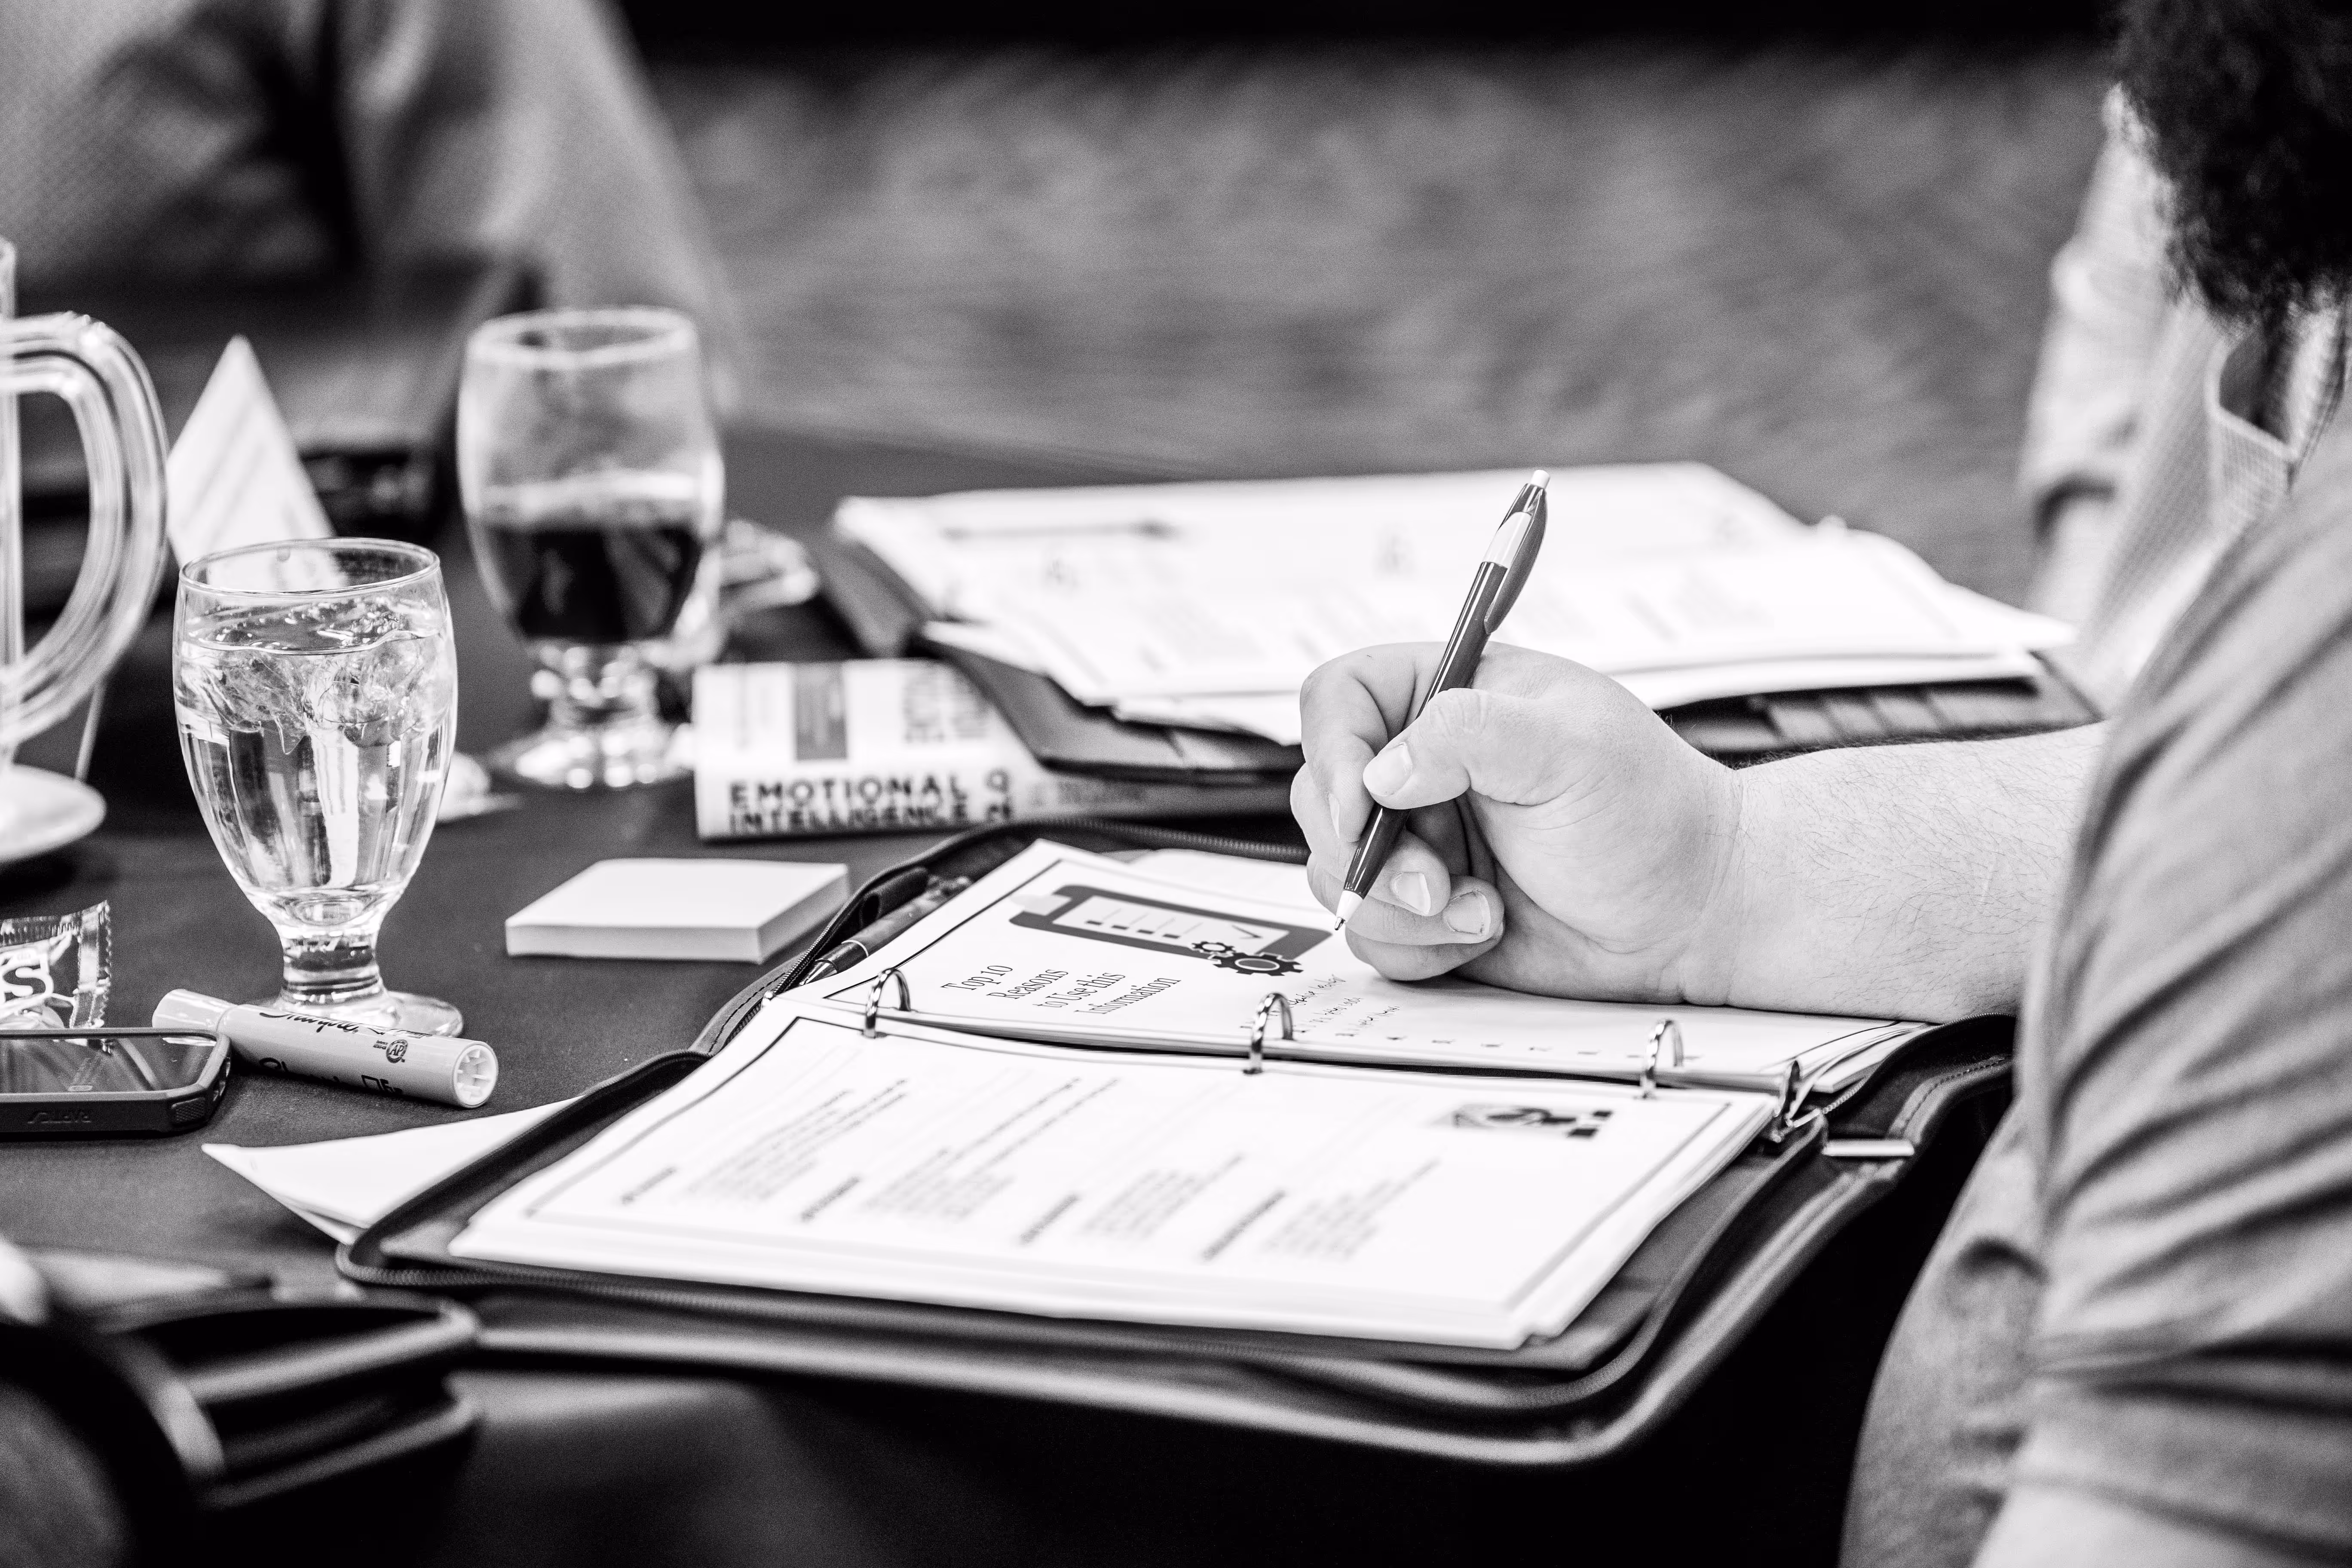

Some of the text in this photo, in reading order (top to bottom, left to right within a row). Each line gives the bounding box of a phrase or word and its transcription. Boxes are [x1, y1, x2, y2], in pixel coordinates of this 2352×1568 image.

[729, 773, 969, 811] EMOTIONAL
[940, 965, 1014, 991] Top 10
[986, 969, 1069, 1000] Reasons
[1044, 987, 1098, 1001] Use
[1076, 972, 1126, 989] this
[1074, 977, 1182, 1015] Information
[388, 1044, 404, 1056] AP
